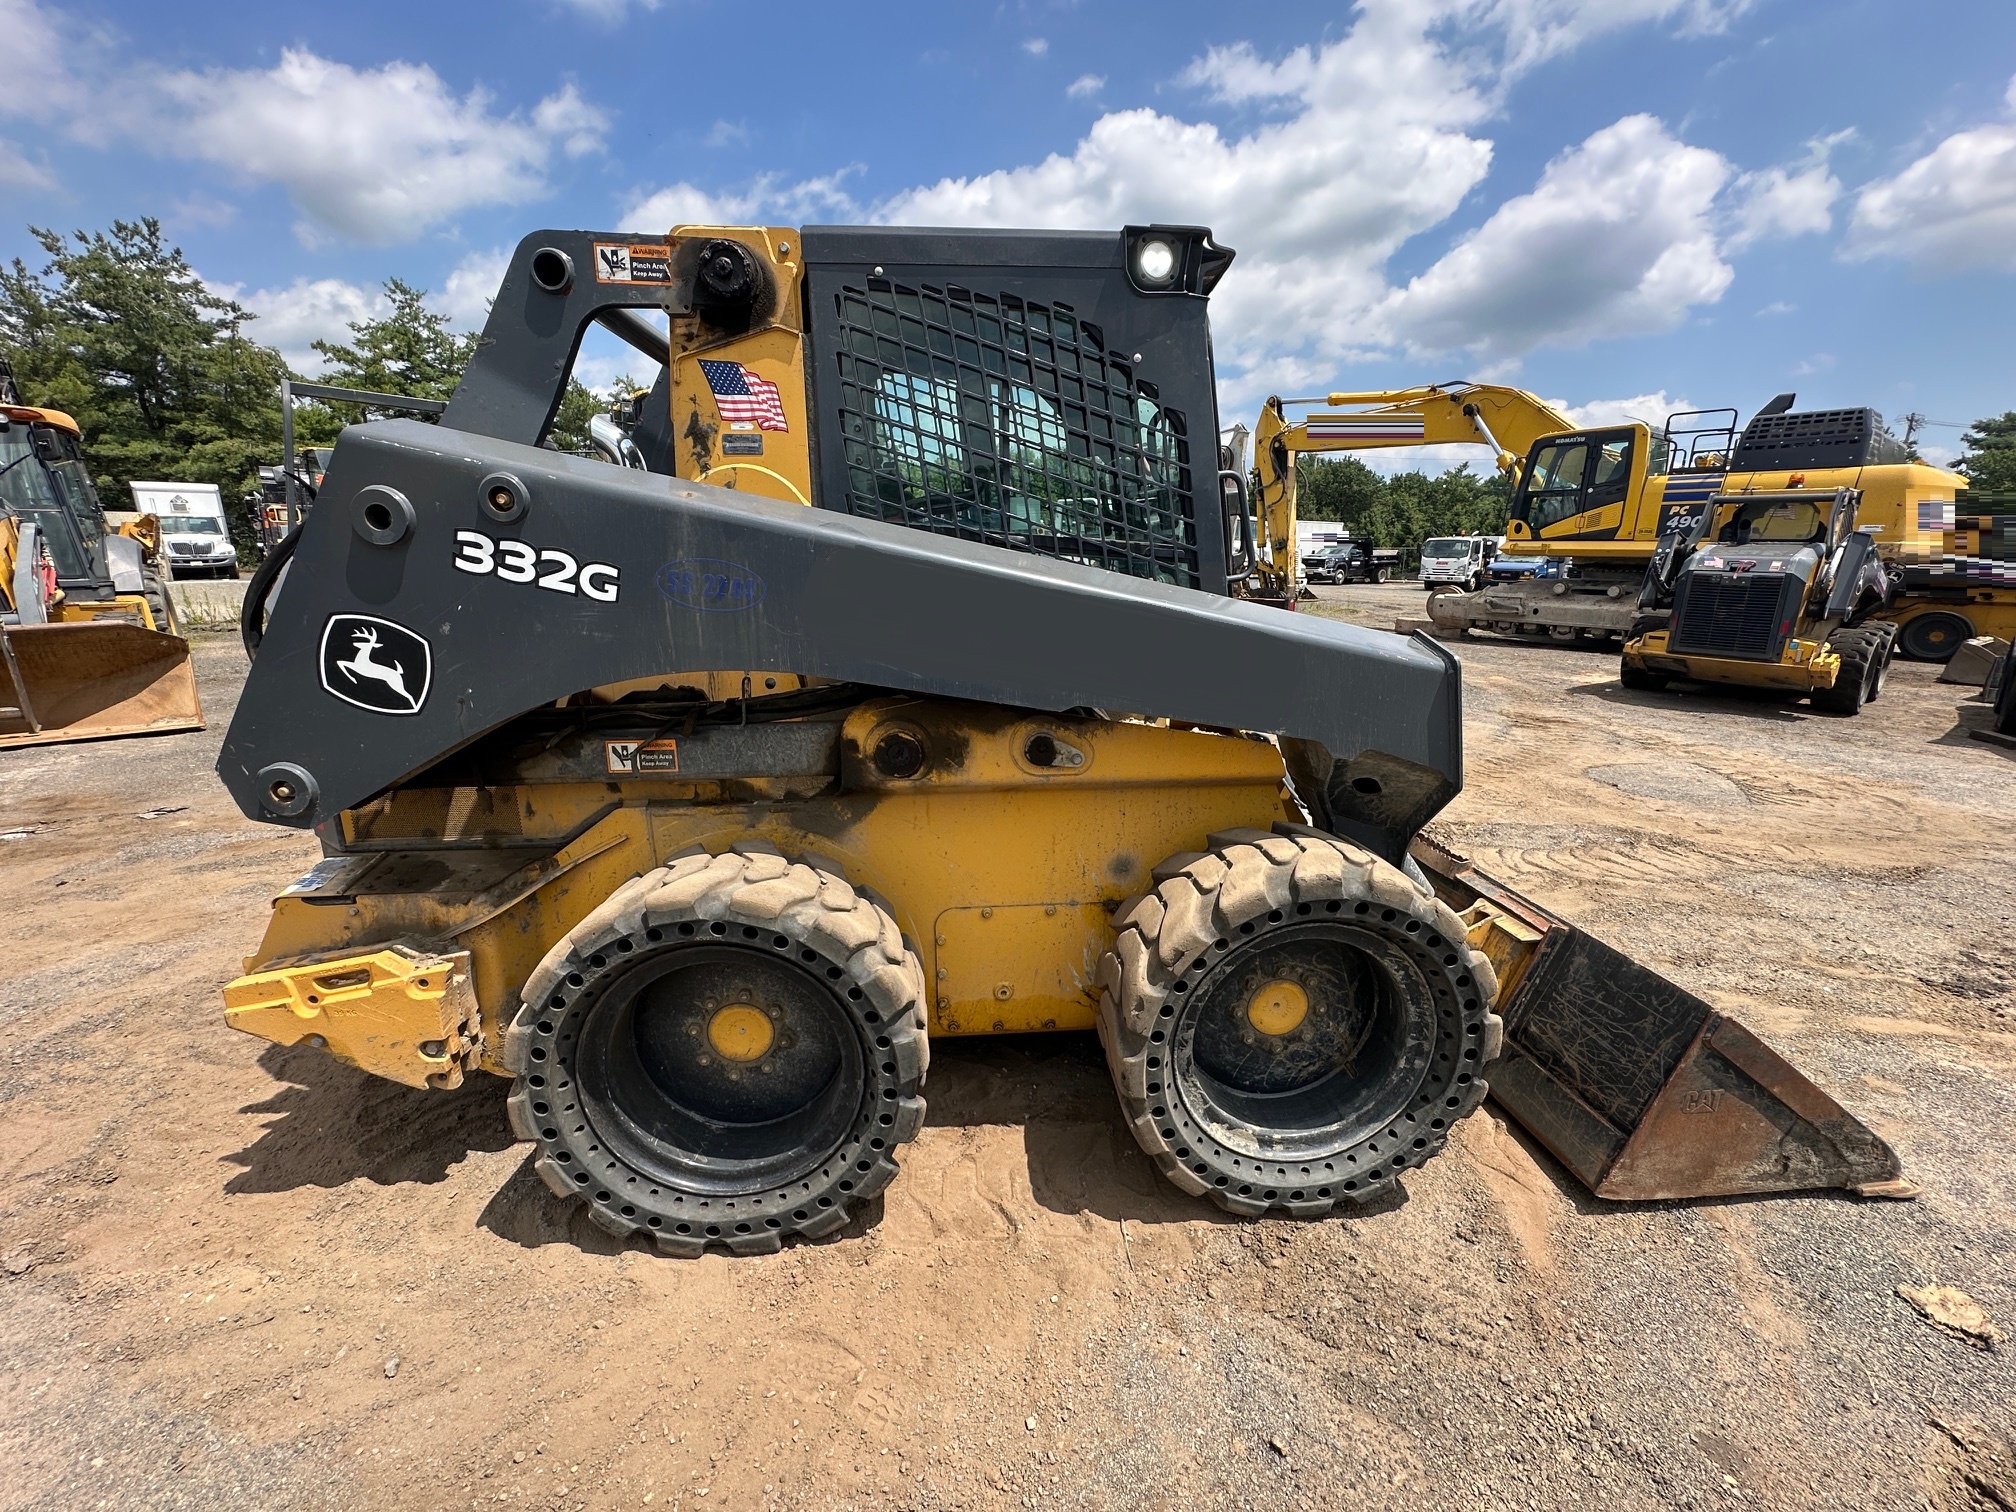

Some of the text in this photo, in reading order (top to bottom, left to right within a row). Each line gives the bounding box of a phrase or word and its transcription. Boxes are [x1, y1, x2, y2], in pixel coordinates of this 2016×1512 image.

[638, 248, 667, 256] WARNING
[1555, 436, 1586, 444] KOMATSU
[1669, 505, 1690, 515] PC
[453, 529, 621, 603] 332G
[666, 570, 755, 601] SS 2244
[1681, 1089, 1725, 1114] CAT
